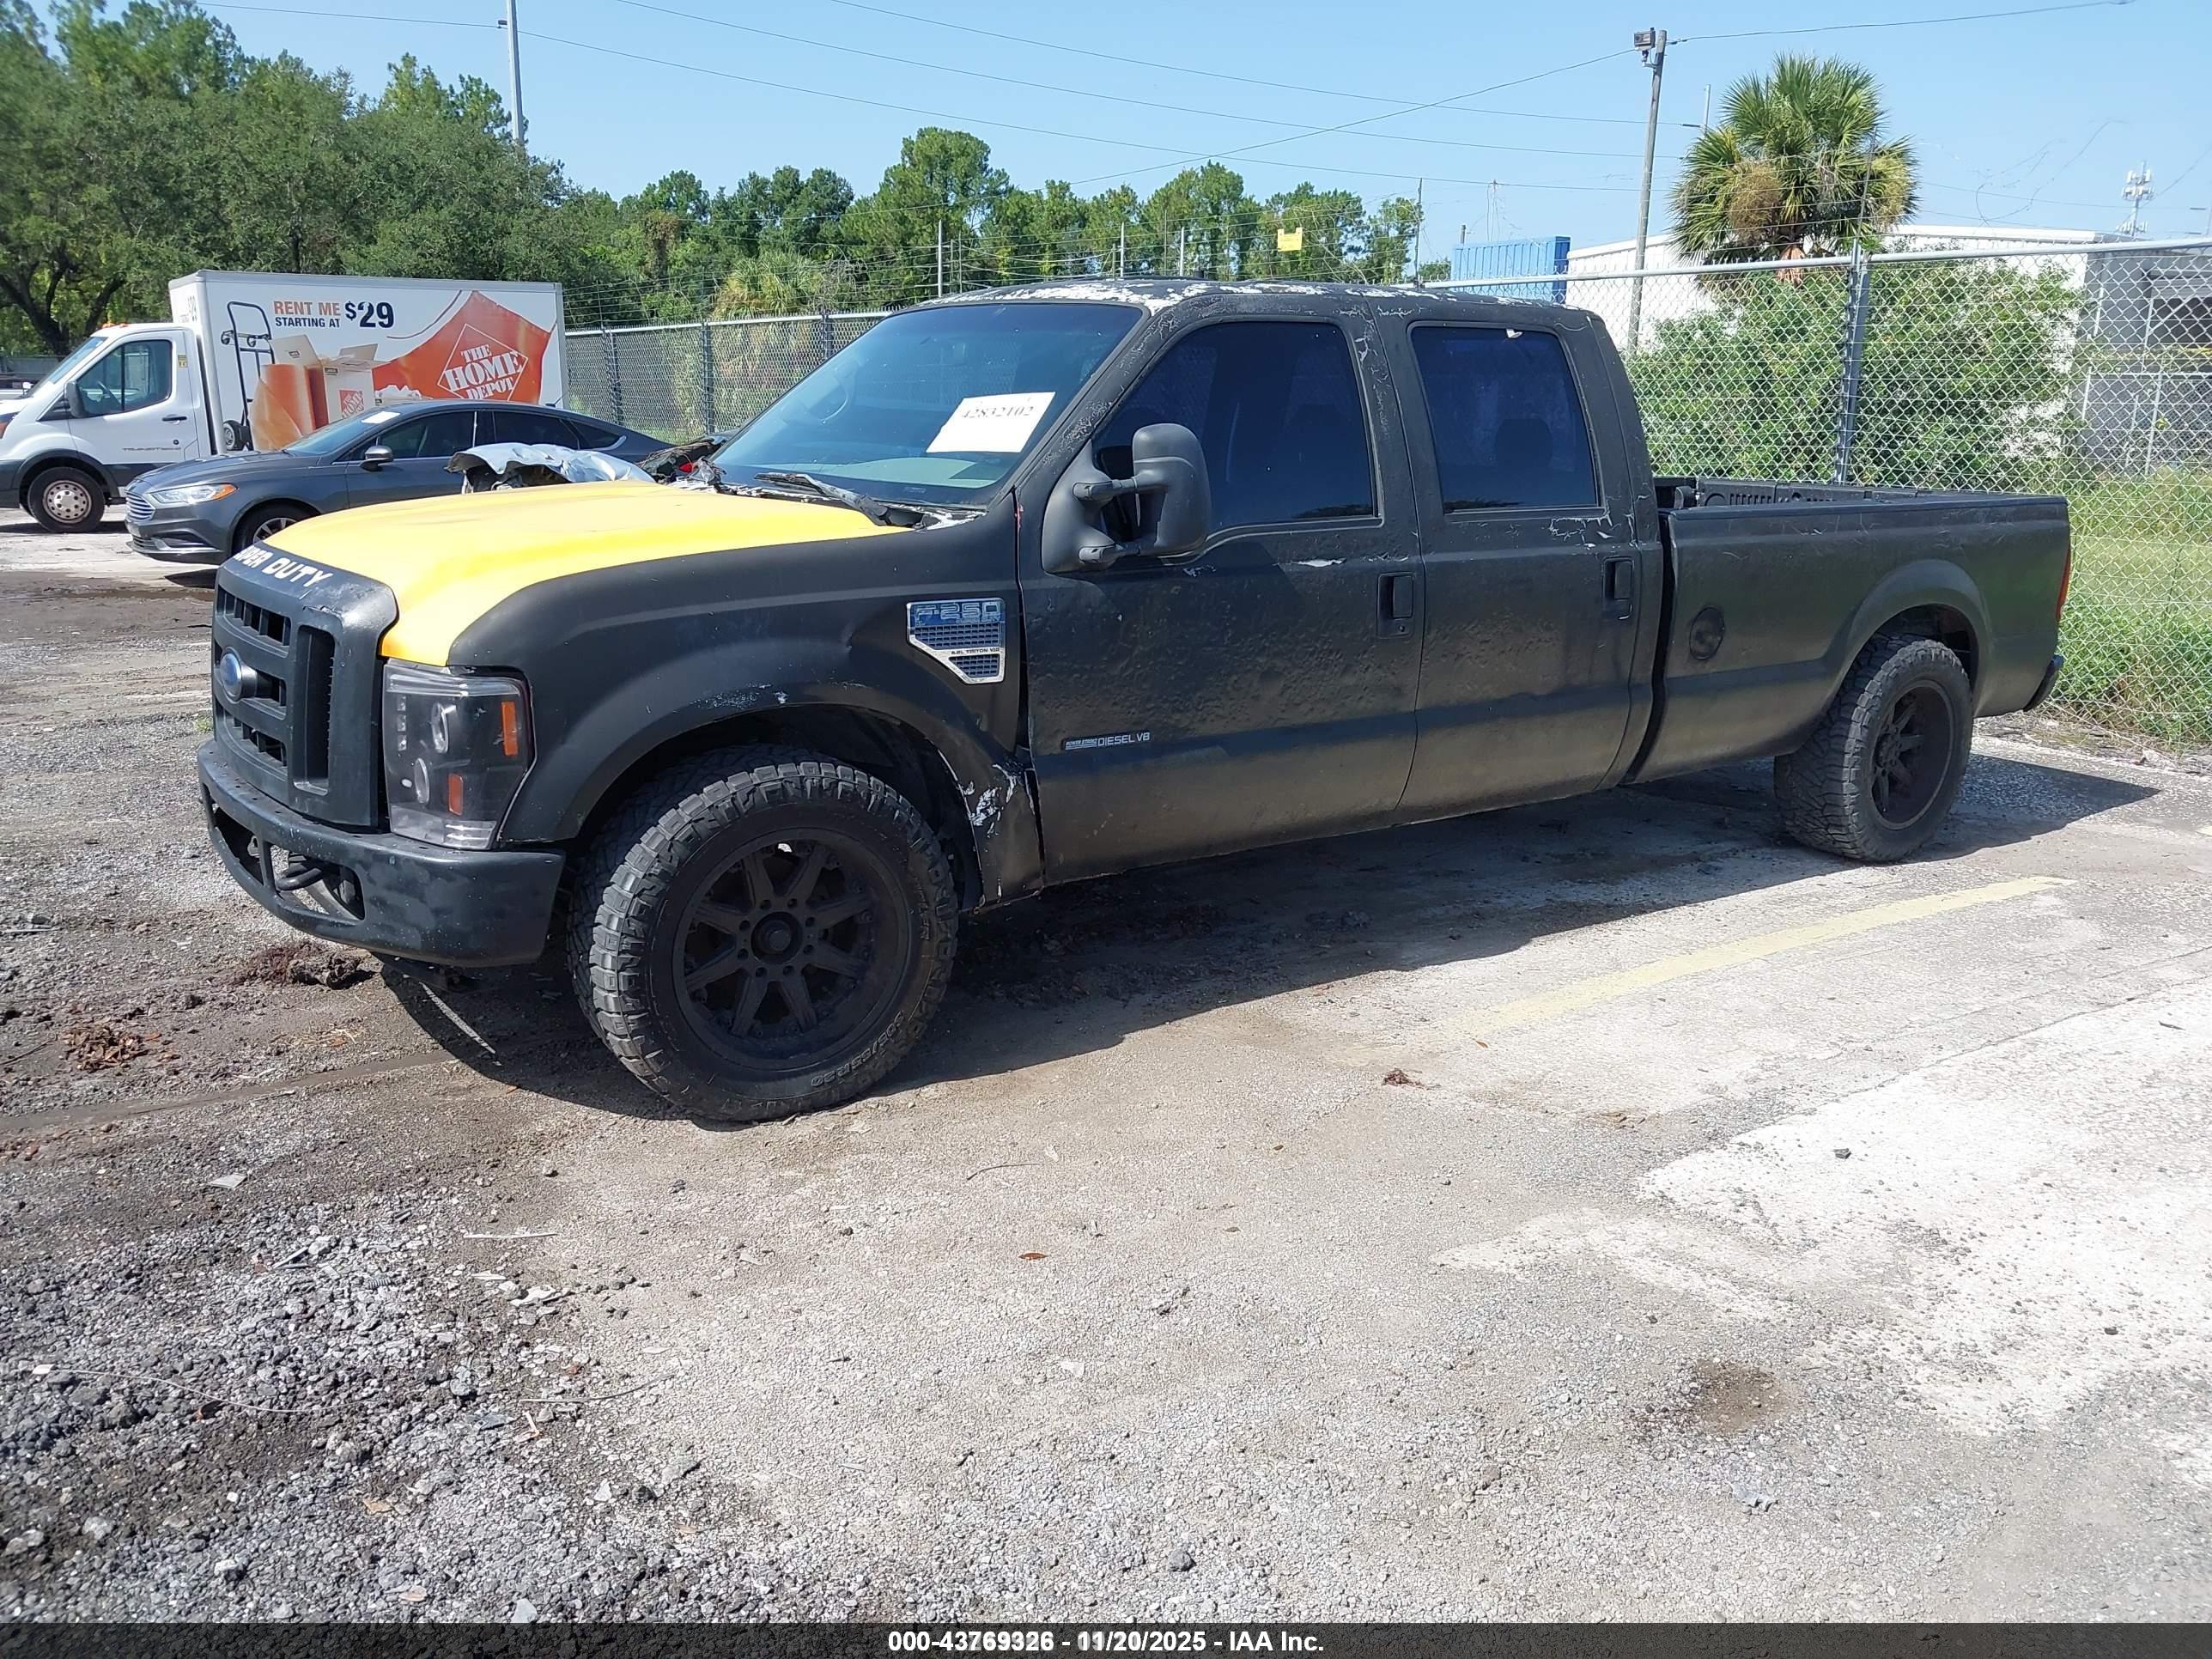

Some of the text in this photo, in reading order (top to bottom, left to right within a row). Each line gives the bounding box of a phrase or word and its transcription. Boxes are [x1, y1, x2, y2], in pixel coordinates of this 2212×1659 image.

[274, 301, 341, 316] RENT ME
[345, 301, 394, 328] $29
[276, 317, 341, 328] STARTING AT
[460, 343, 492, 362] THE
[444, 350, 523, 392] HOME
[465, 377, 515, 399] DEPOT
[261, 557, 334, 587] DUTY
[915, 601, 1001, 624] F-250
[1097, 732, 1151, 747] DIESEL V8
